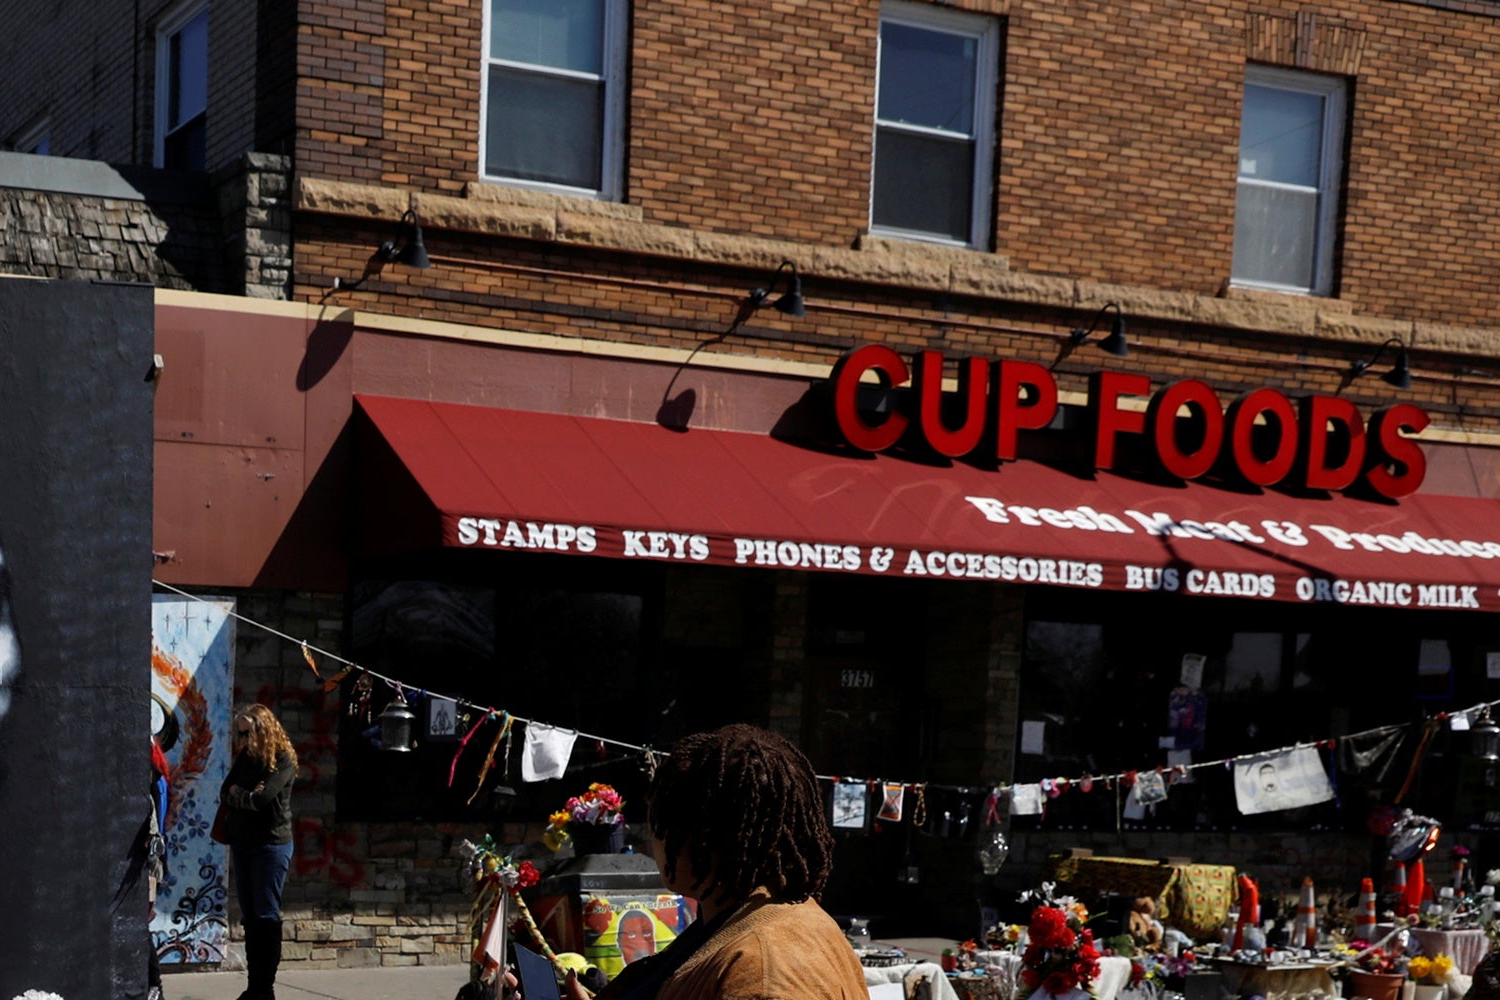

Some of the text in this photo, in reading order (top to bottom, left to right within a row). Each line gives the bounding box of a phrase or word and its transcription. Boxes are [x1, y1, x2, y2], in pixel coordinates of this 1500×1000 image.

[836, 344, 1431, 498] CUP FOODS
[966, 496, 1134, 534] Fresh
[1126, 510, 1265, 545] Meat
[1261, 520, 1309, 547] &
[458, 517, 1480, 609] STAMPS KEYS PHONES & ACCESSORIES BUS CARDS ORGANIC MILK
[840, 668, 874, 688] 3757
